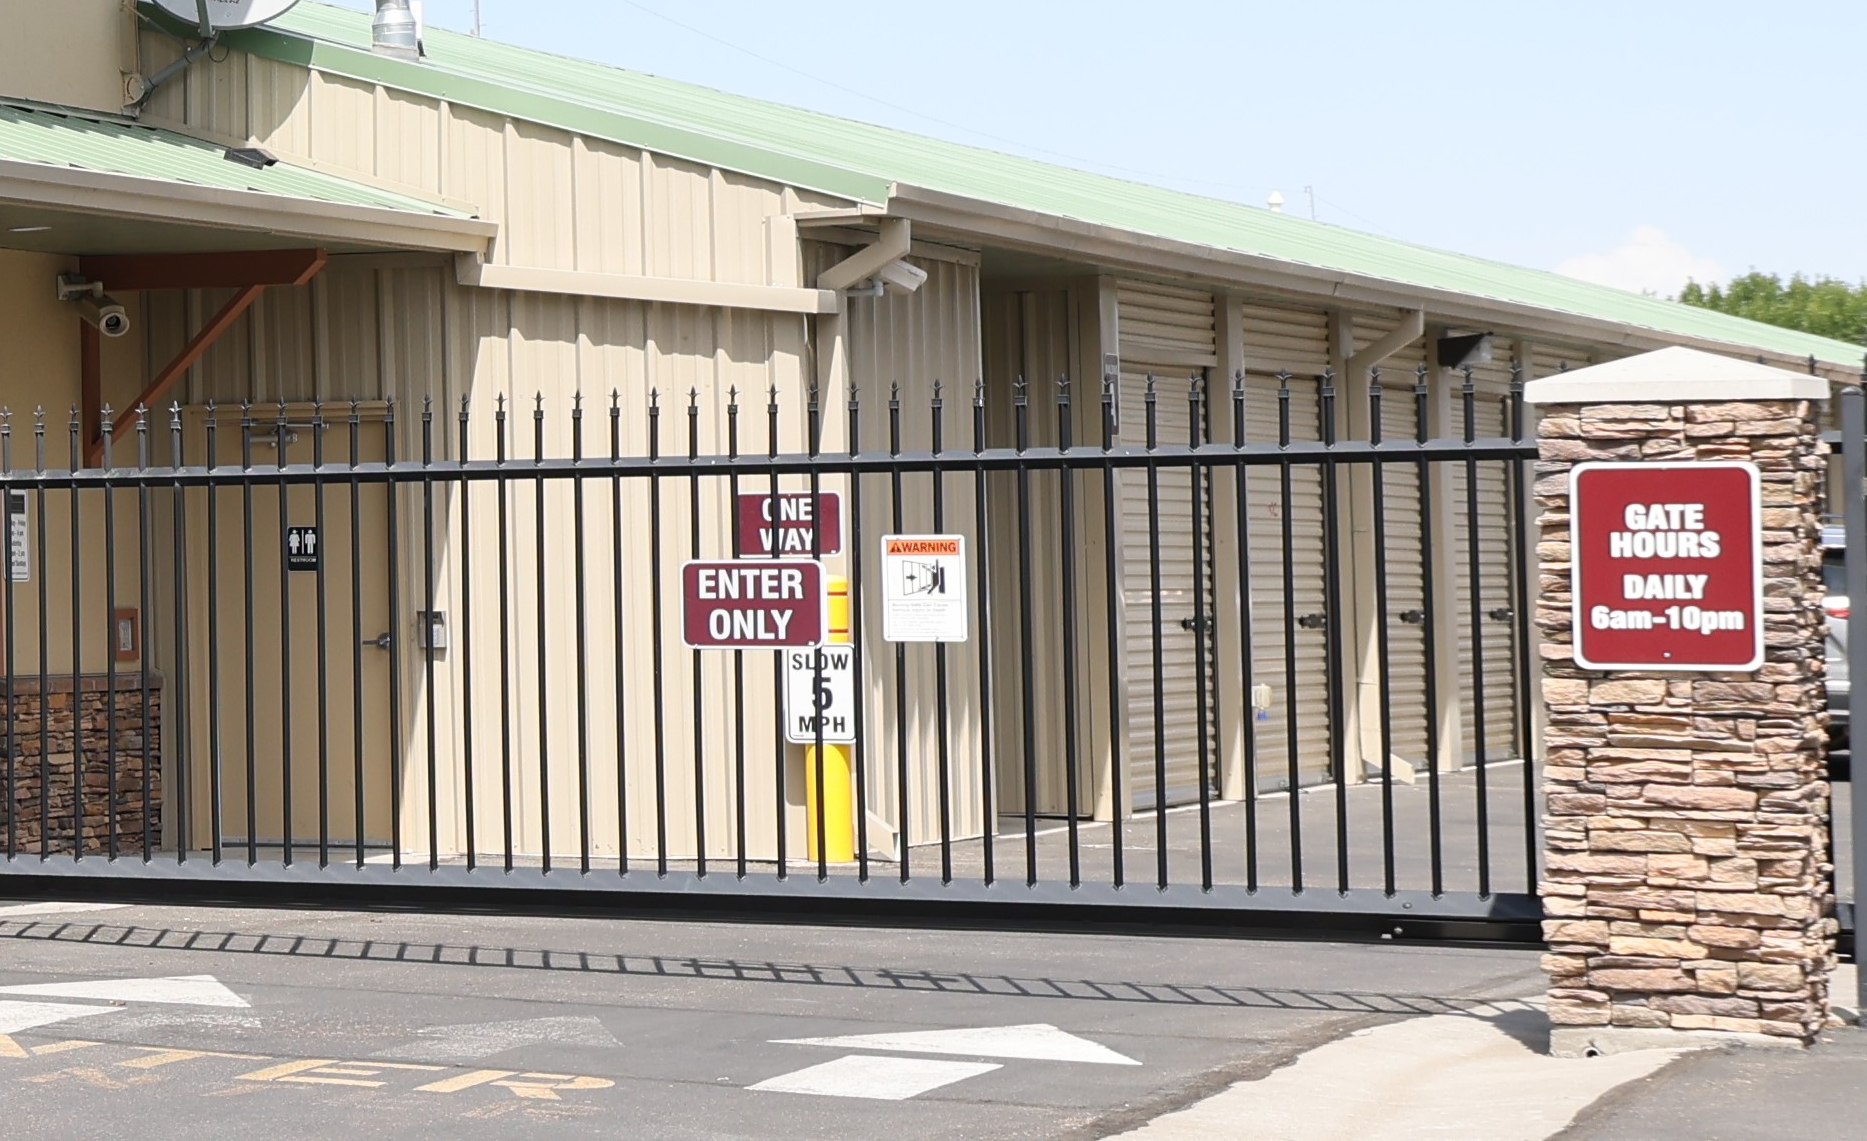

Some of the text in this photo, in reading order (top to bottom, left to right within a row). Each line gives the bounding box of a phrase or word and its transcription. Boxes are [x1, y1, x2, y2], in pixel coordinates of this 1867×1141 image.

[1624, 504, 1704, 530] GATE
[759, 528, 814, 551] WAY
[902, 542, 956, 553] WARNING
[1610, 531, 1721, 558] HOURS
[698, 569, 803, 600] ENTER
[1623, 574, 1708, 600] DAILY
[709, 609, 793, 640] ONLY
[1591, 605, 1744, 635] 6am-10pm
[812, 677, 834, 710] 5
[799, 716, 846, 733] MPH
